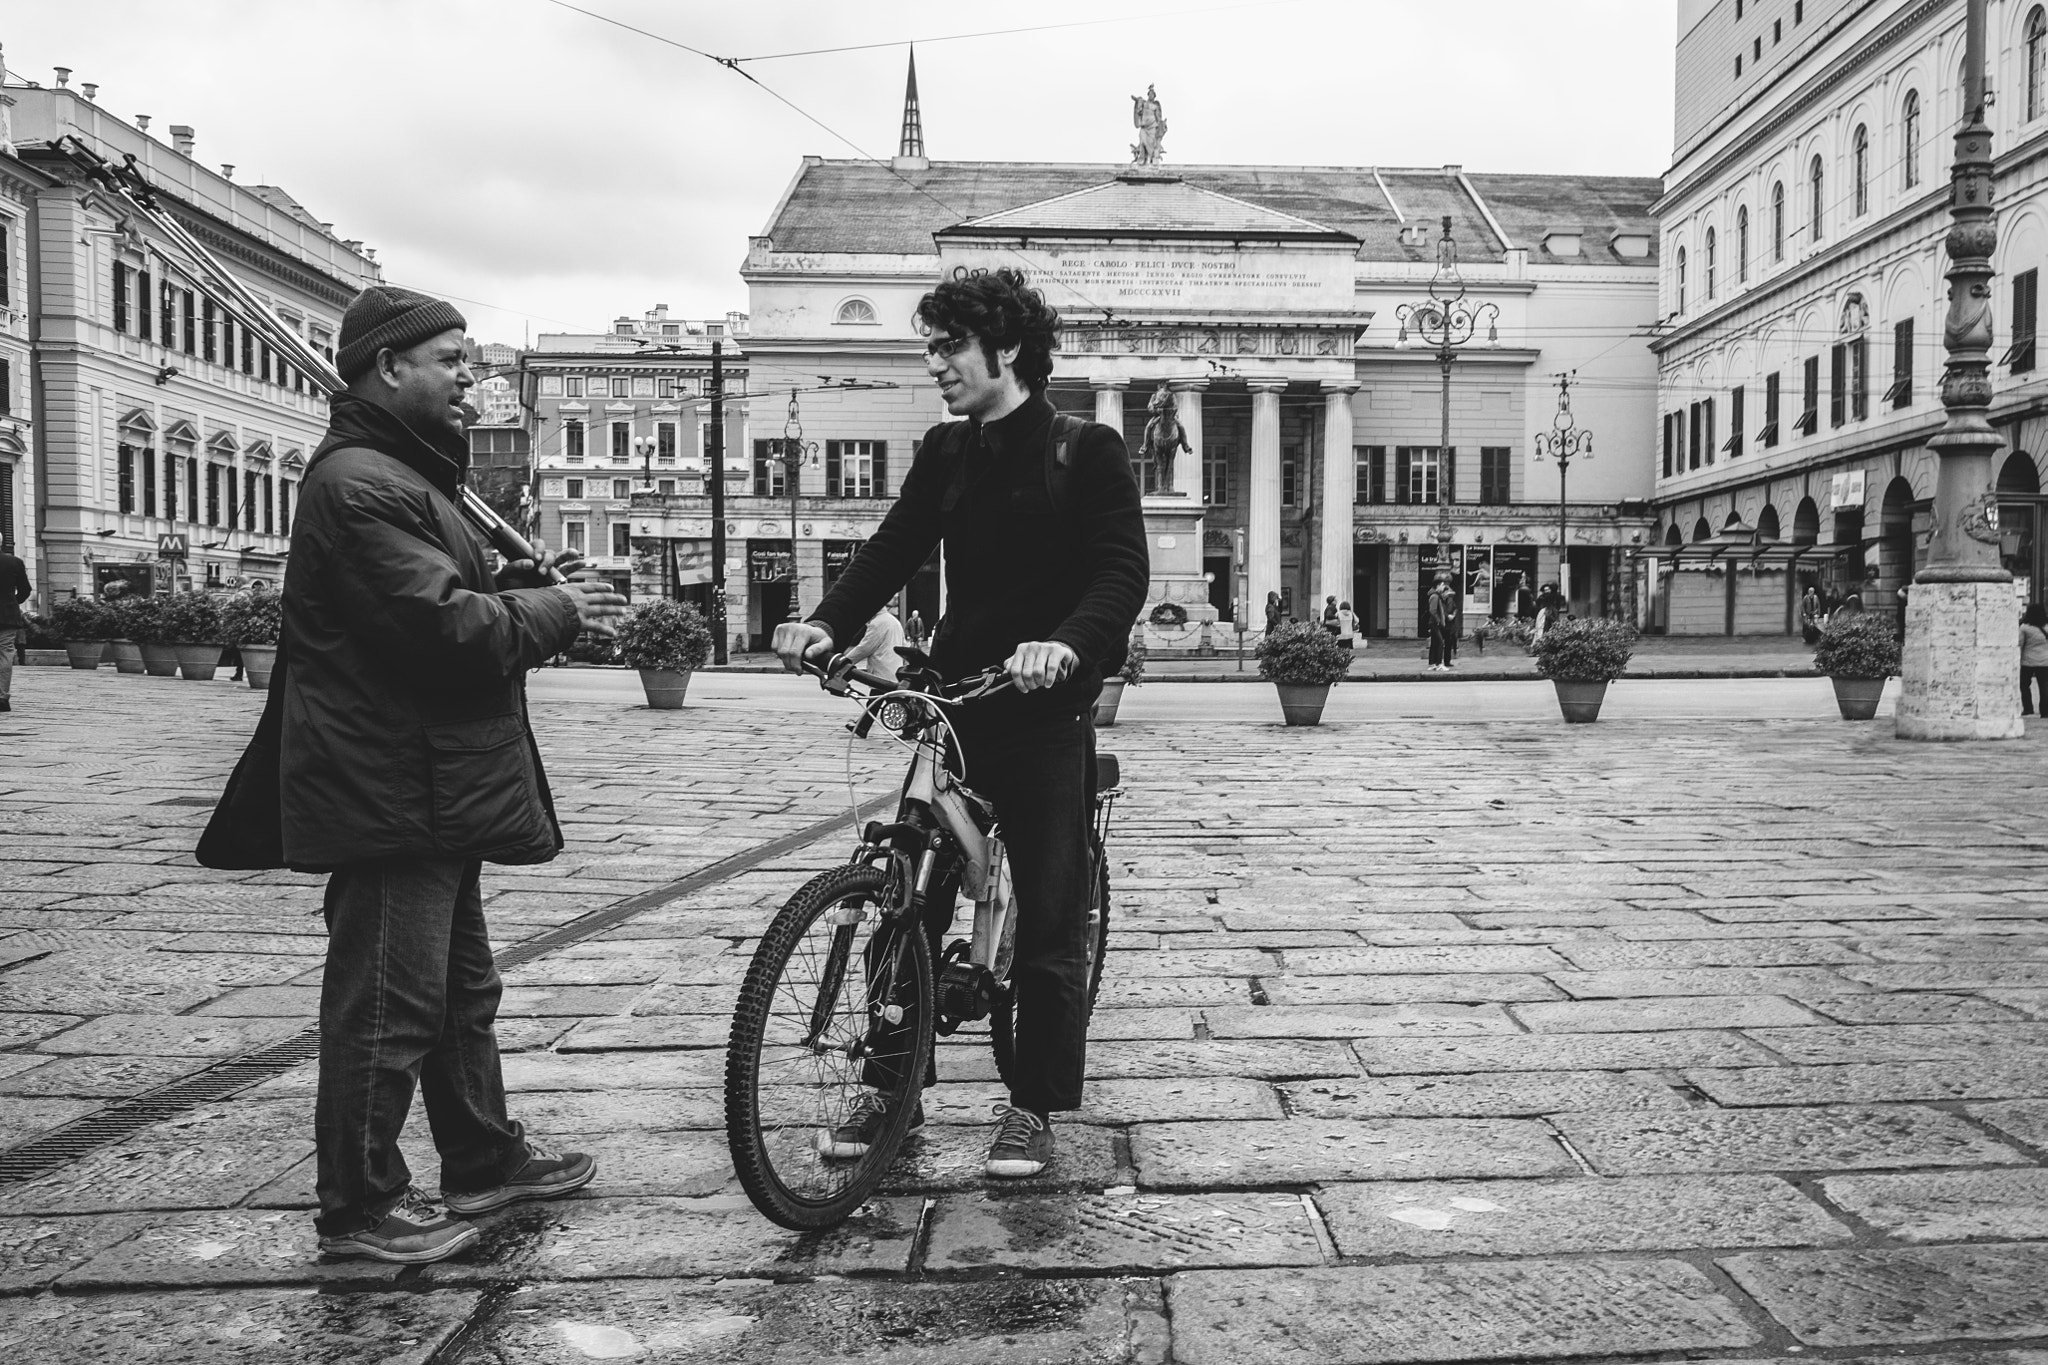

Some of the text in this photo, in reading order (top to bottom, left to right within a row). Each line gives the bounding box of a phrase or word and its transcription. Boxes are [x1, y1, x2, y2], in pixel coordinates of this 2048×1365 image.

[1093, 260, 1129, 269] CAROLO
[1135, 261, 1165, 269] FELICI
[1171, 261, 1195, 269] DVCE
[1118, 288, 1181, 297] MDCCCXXVII
[160, 536, 183, 550] M
